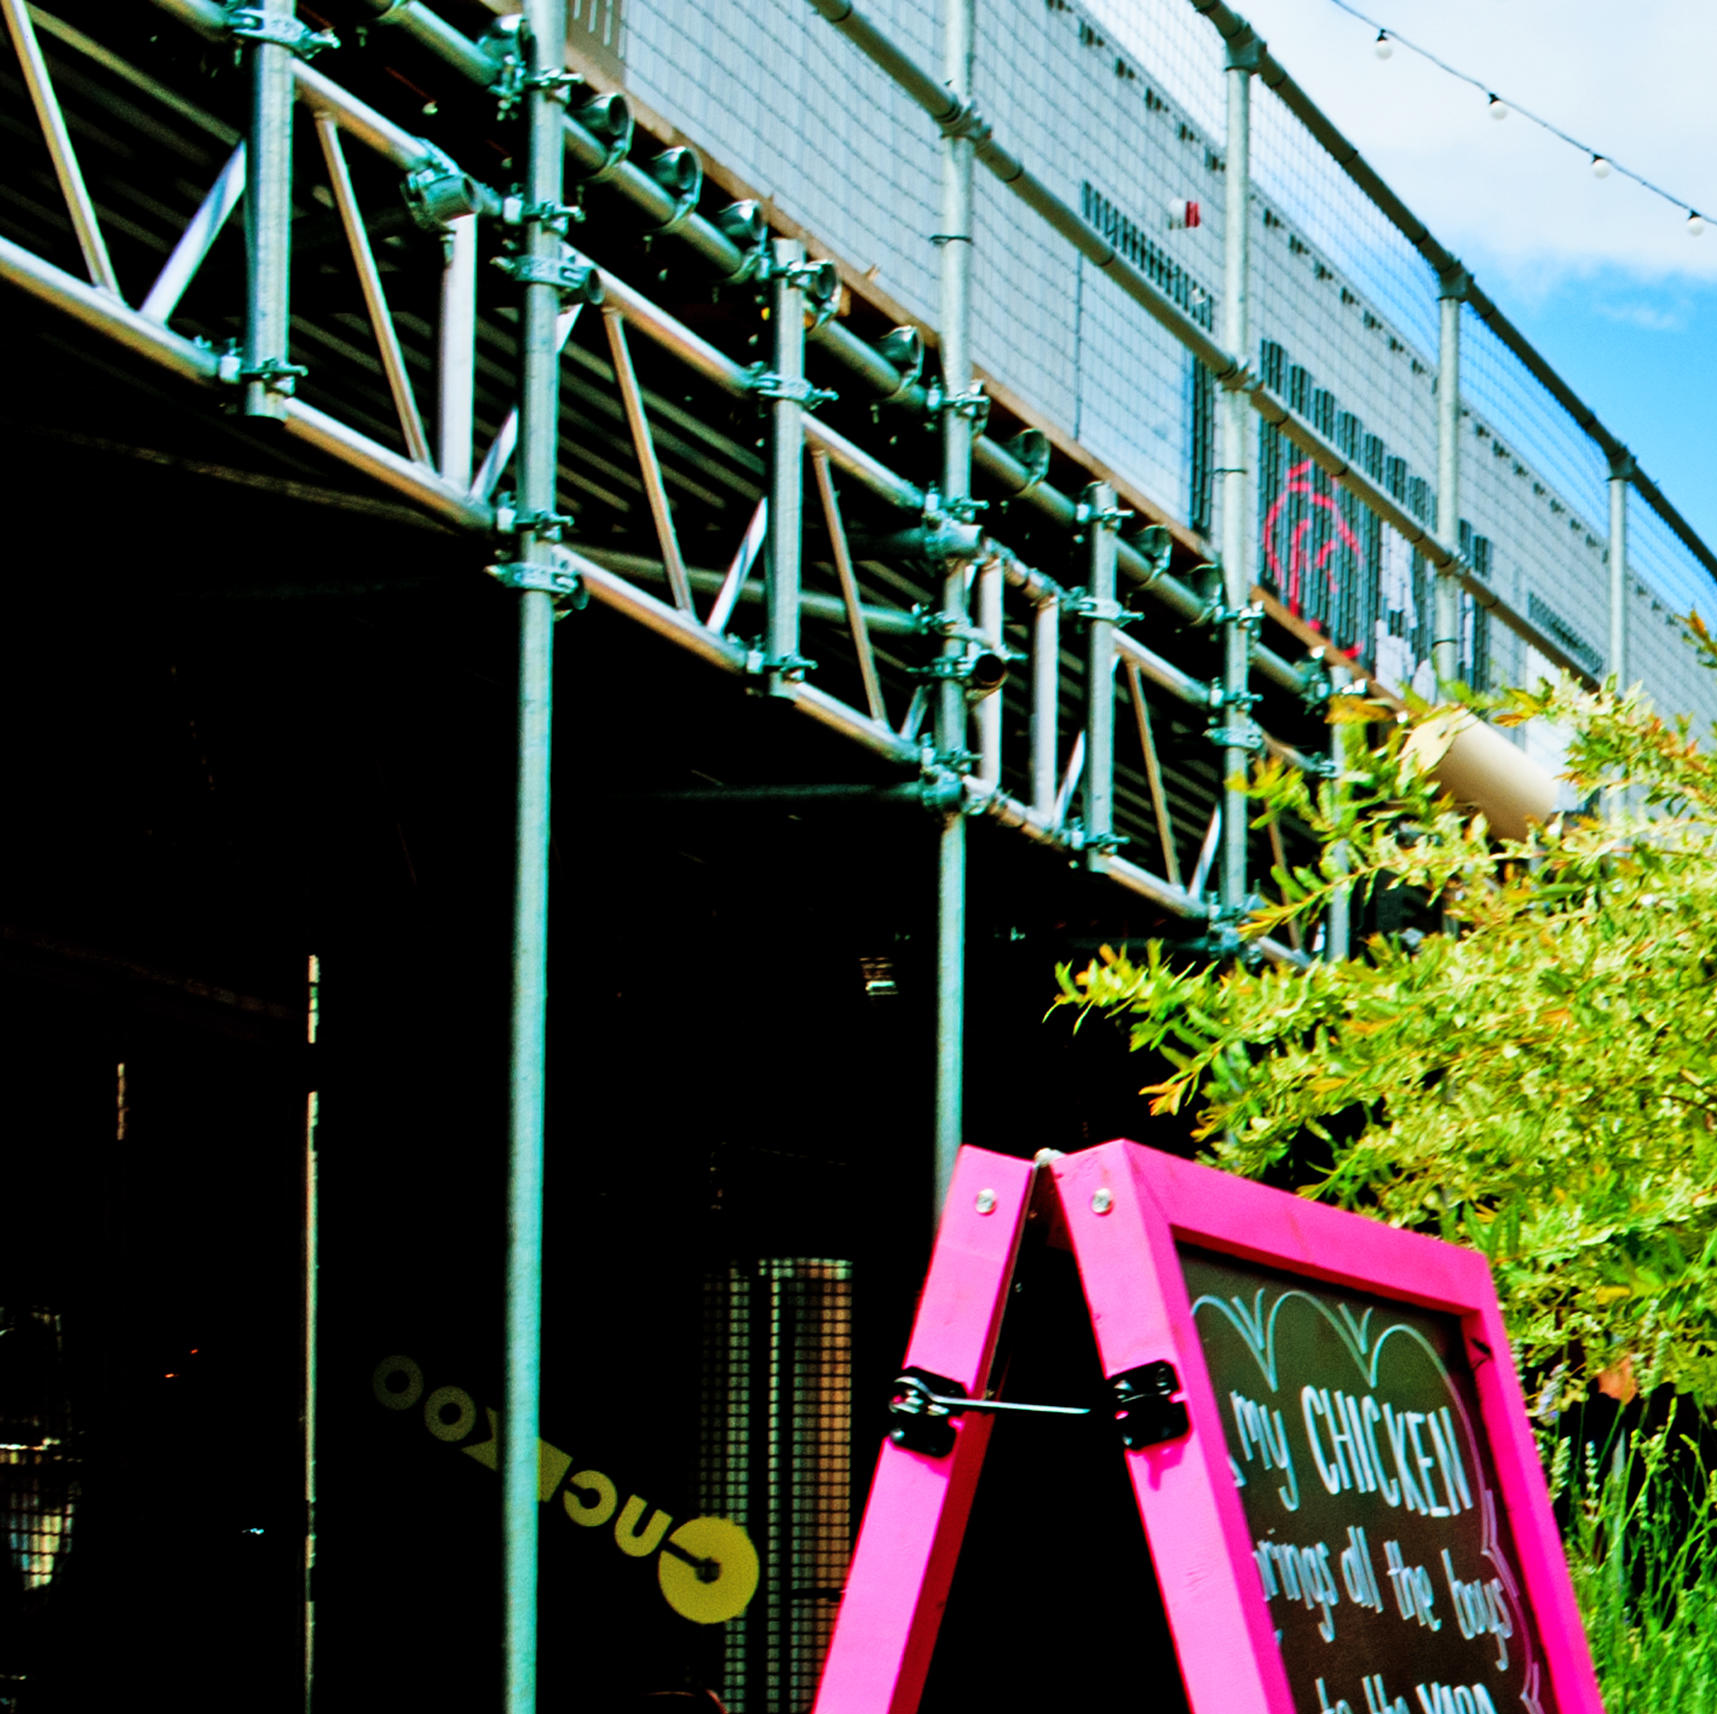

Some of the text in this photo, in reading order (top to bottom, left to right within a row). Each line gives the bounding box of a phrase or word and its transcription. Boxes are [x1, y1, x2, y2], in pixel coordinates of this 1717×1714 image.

[1230, 1385, 1474, 1517] my CHICKEN
[1252, 1525, 1514, 1672] rings all the boys
